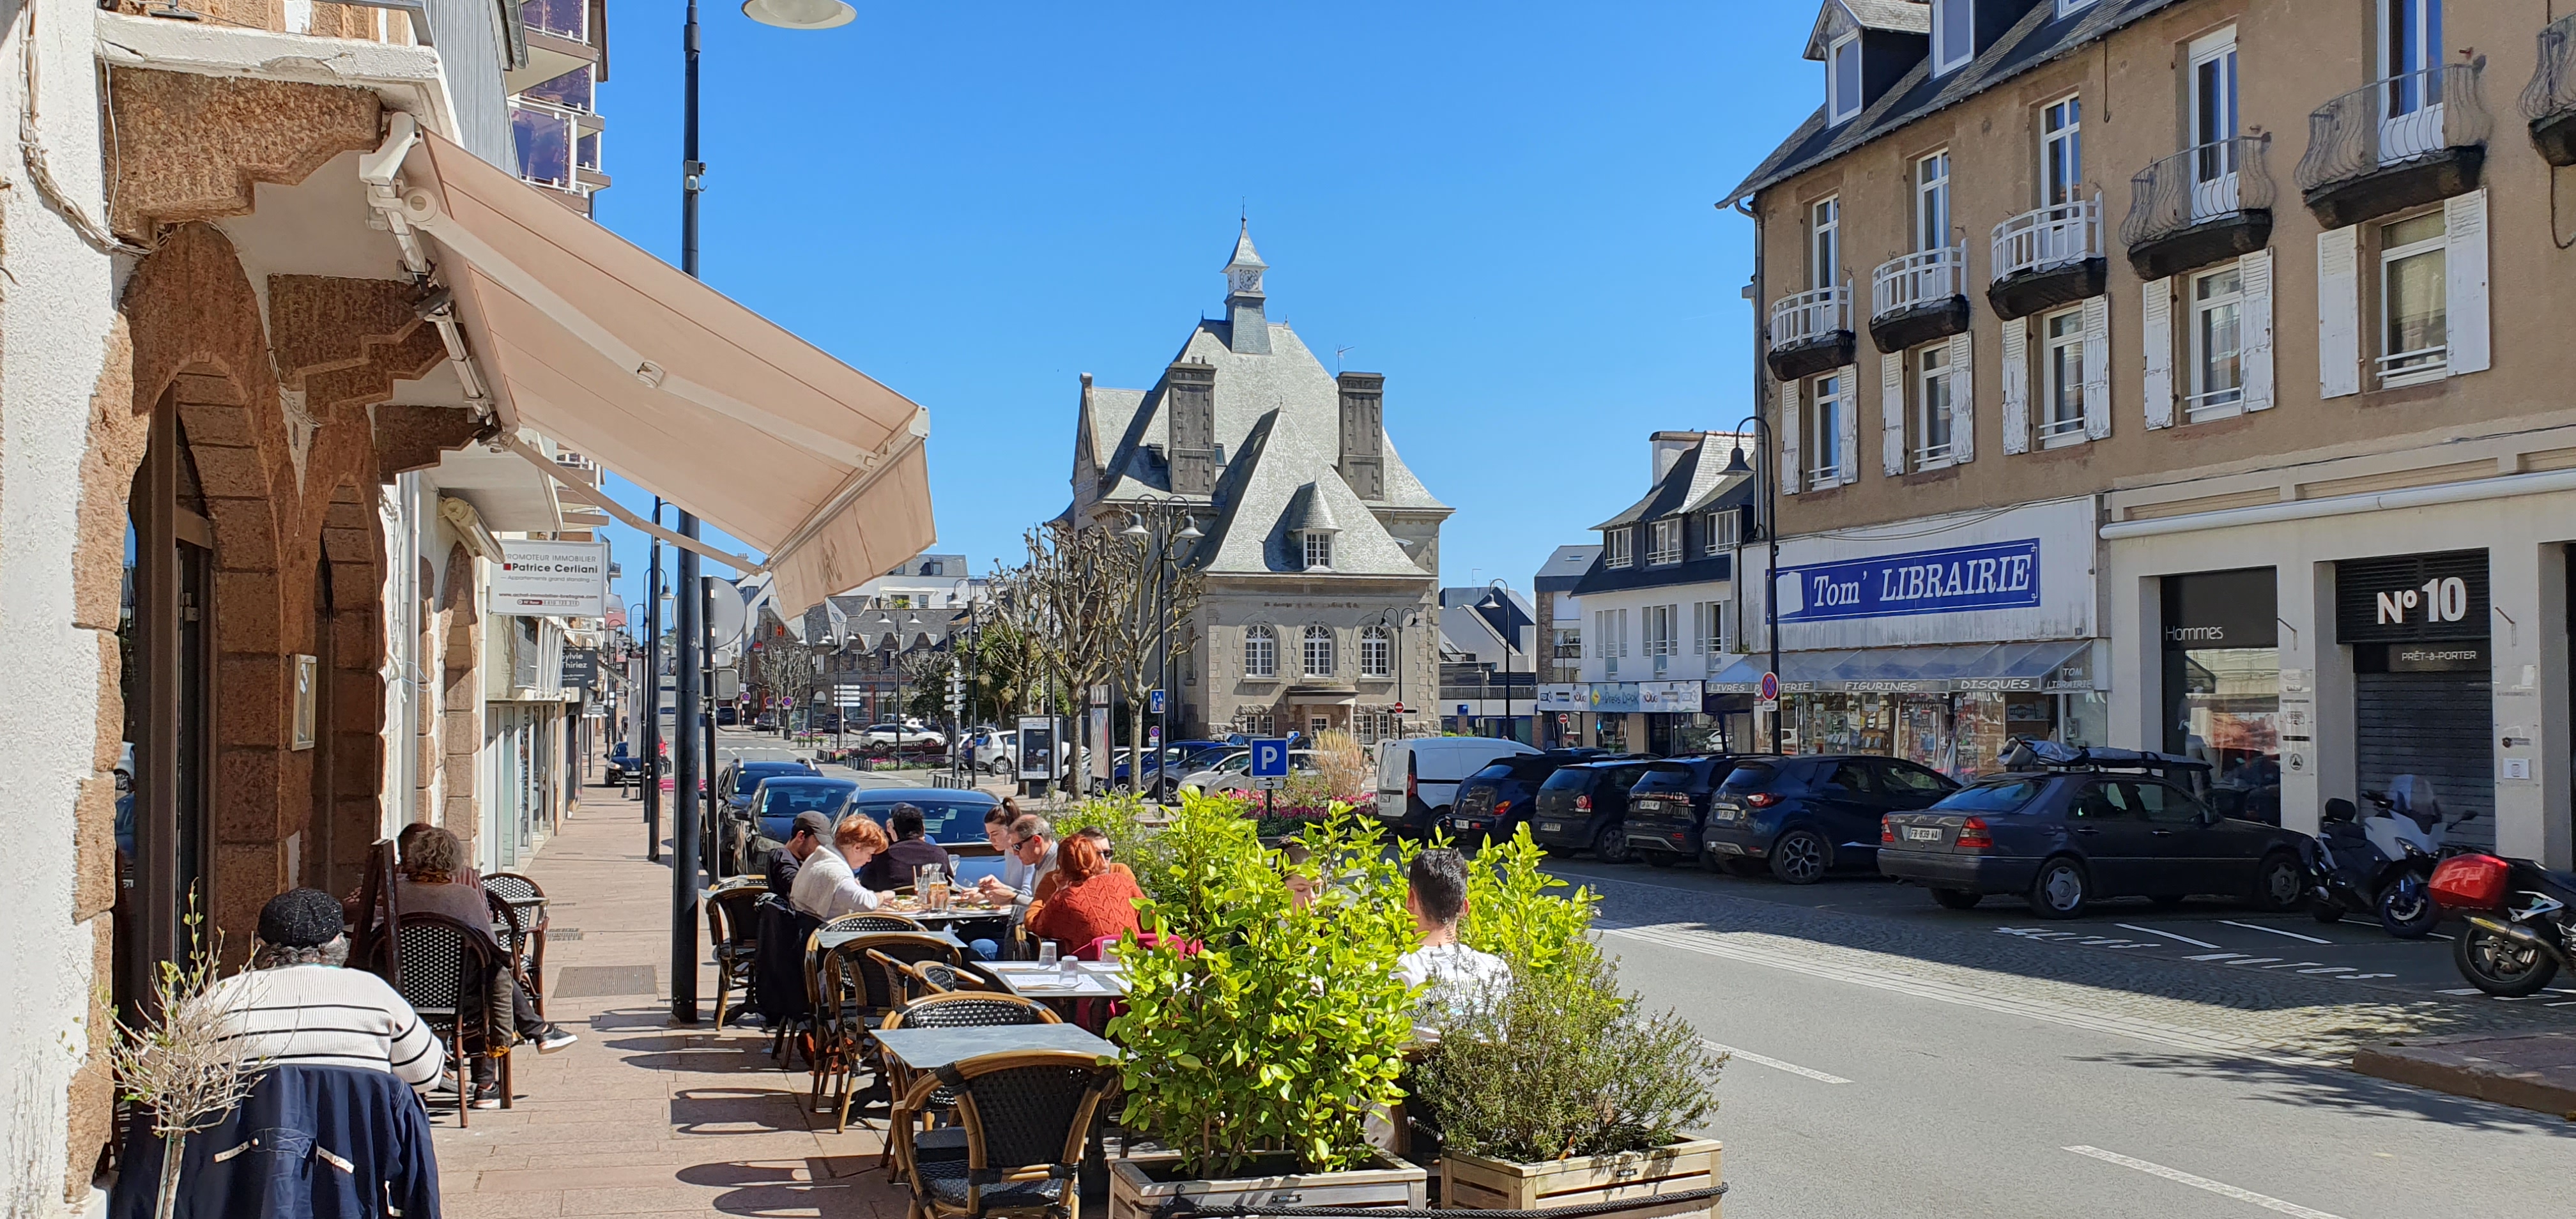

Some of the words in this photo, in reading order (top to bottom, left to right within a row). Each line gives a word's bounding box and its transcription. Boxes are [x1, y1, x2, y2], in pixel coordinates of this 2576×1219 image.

[512, 563, 551, 572] Patrice
[555, 564, 598, 574] Cerliani
[1879, 554, 2032, 602] LIBRAIRIE
[2165, 625, 2223, 641] Hommes
[562, 652, 583, 661] Sylvie
[2063, 667, 2083, 677] TOM
[1844, 681, 1917, 692] FIGURINES
[1961, 679, 2030, 691] DISQUES
[2046, 678, 2092, 689] LIBRAIRIE
[1261, 746, 1278, 770] P
